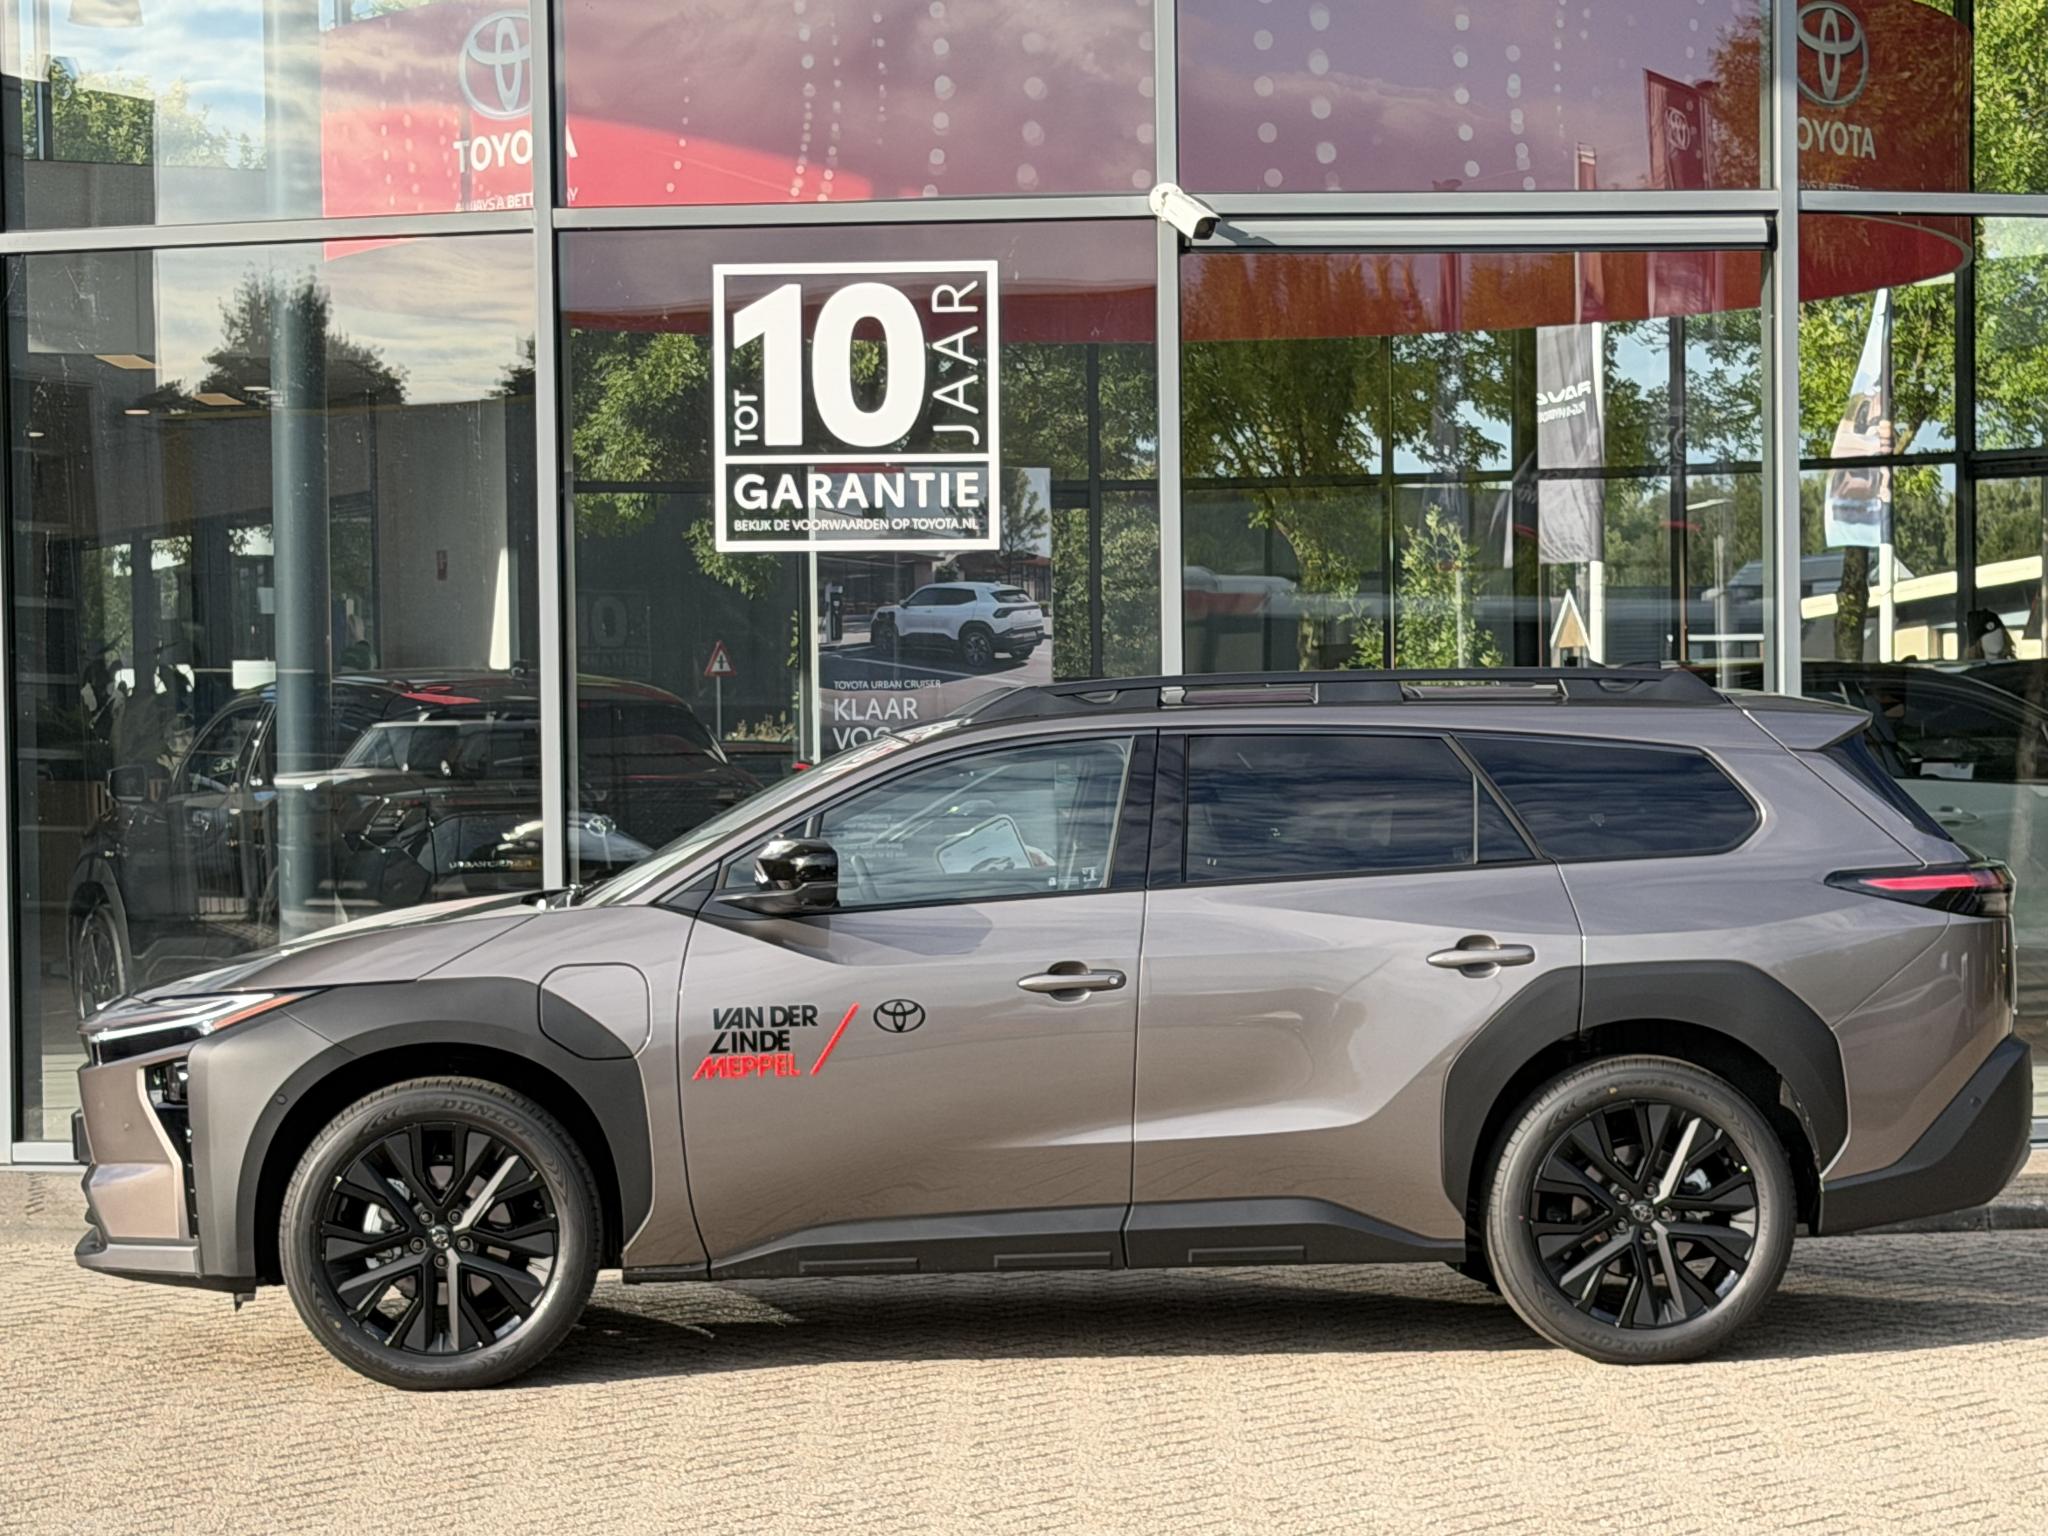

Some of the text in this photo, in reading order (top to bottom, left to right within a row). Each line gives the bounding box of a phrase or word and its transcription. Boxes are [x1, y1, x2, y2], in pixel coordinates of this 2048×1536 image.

[1798, 116, 1877, 161] OYOTA
[507, 192, 534, 208] BETT
[733, 282, 926, 447] 10
[931, 280, 979, 445] JAAR
[733, 389, 759, 447] TOT
[734, 471, 980, 510] GARANTIE
[734, 517, 979, 532] BEKIJK DE VOORWAARDEN OP TOYOTA.NL
[833, 679, 941, 690] TOYOTA URBAN CRUISER
[834, 697, 919, 721] KLAAR
[713, 1004, 818, 1030] VAN DER
[709, 1030, 790, 1054] LINDE
[692, 1053, 801, 1081] MEPPEL
[441, 1099, 535, 1138] DUNLOP
